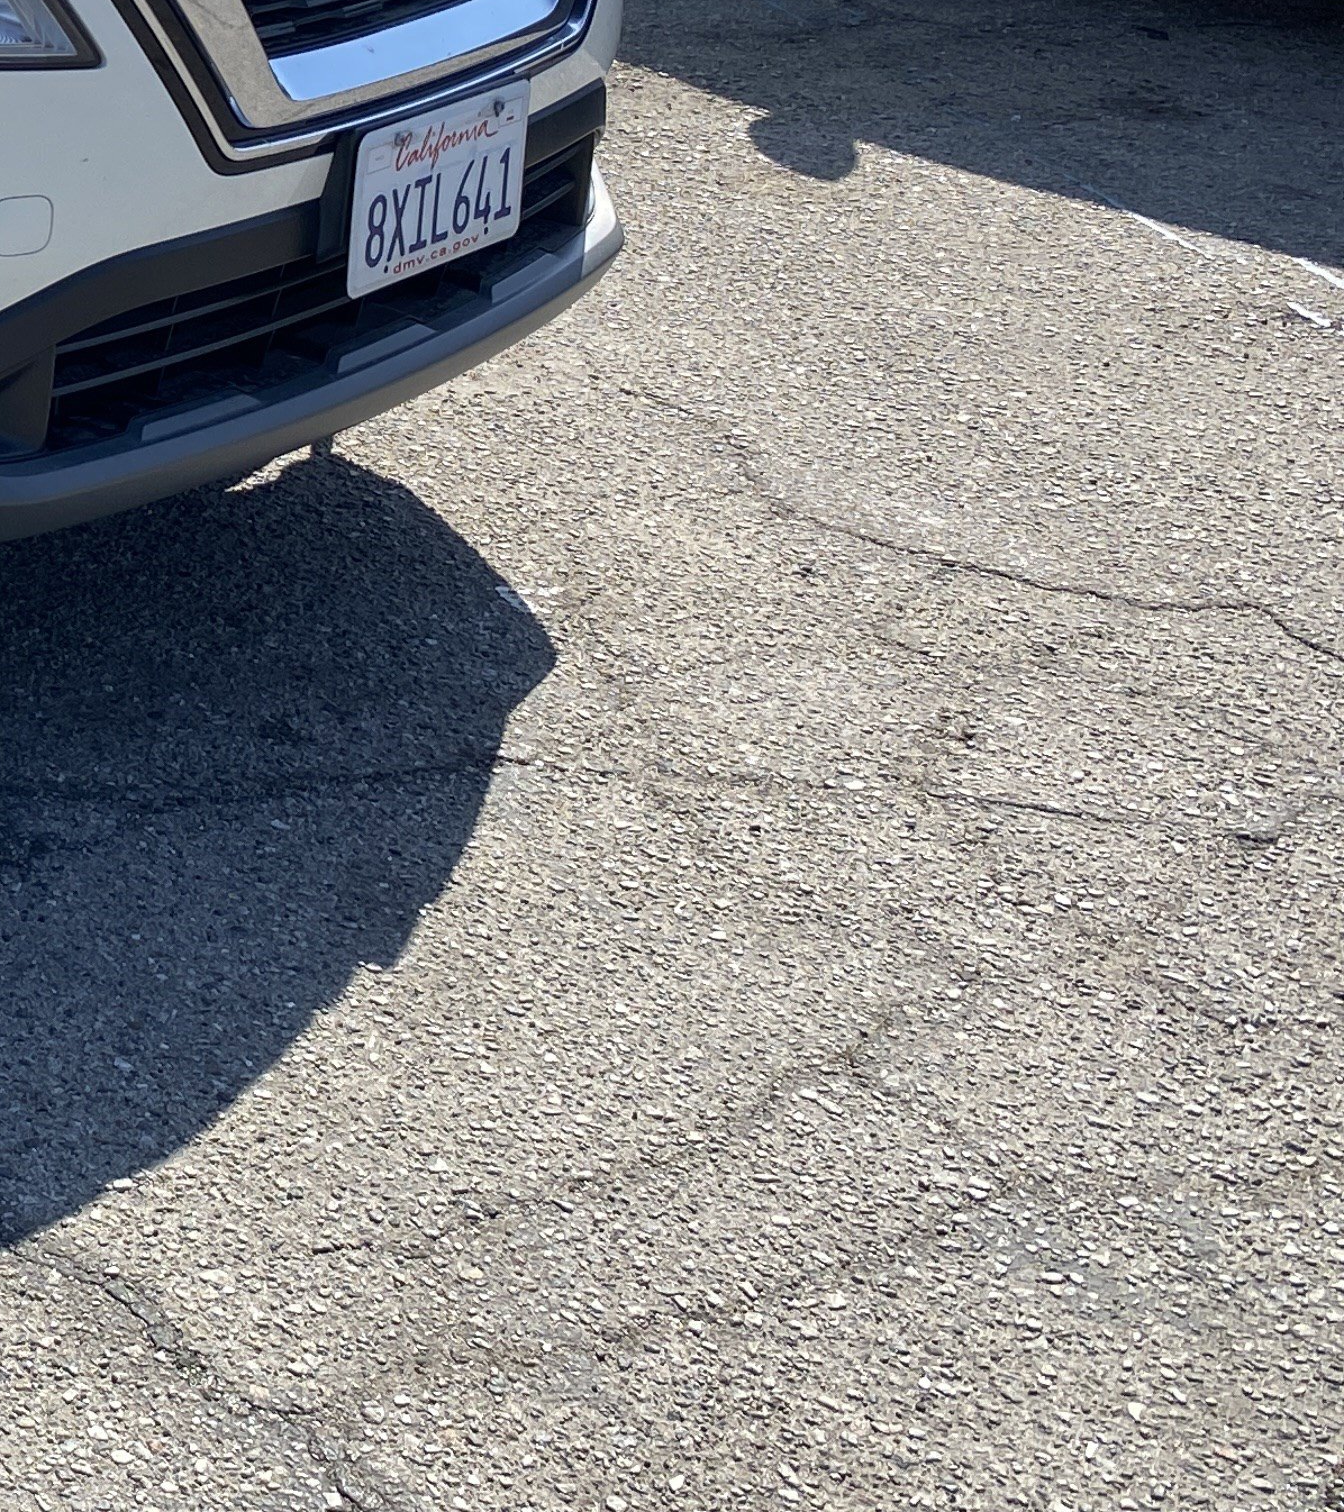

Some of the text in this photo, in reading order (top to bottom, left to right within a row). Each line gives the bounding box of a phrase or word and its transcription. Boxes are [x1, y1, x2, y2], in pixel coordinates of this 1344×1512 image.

[394, 120, 500, 172] California
[364, 147, 512, 269] 8XIL641
[393, 234, 480, 275] dmv.ca.gov
